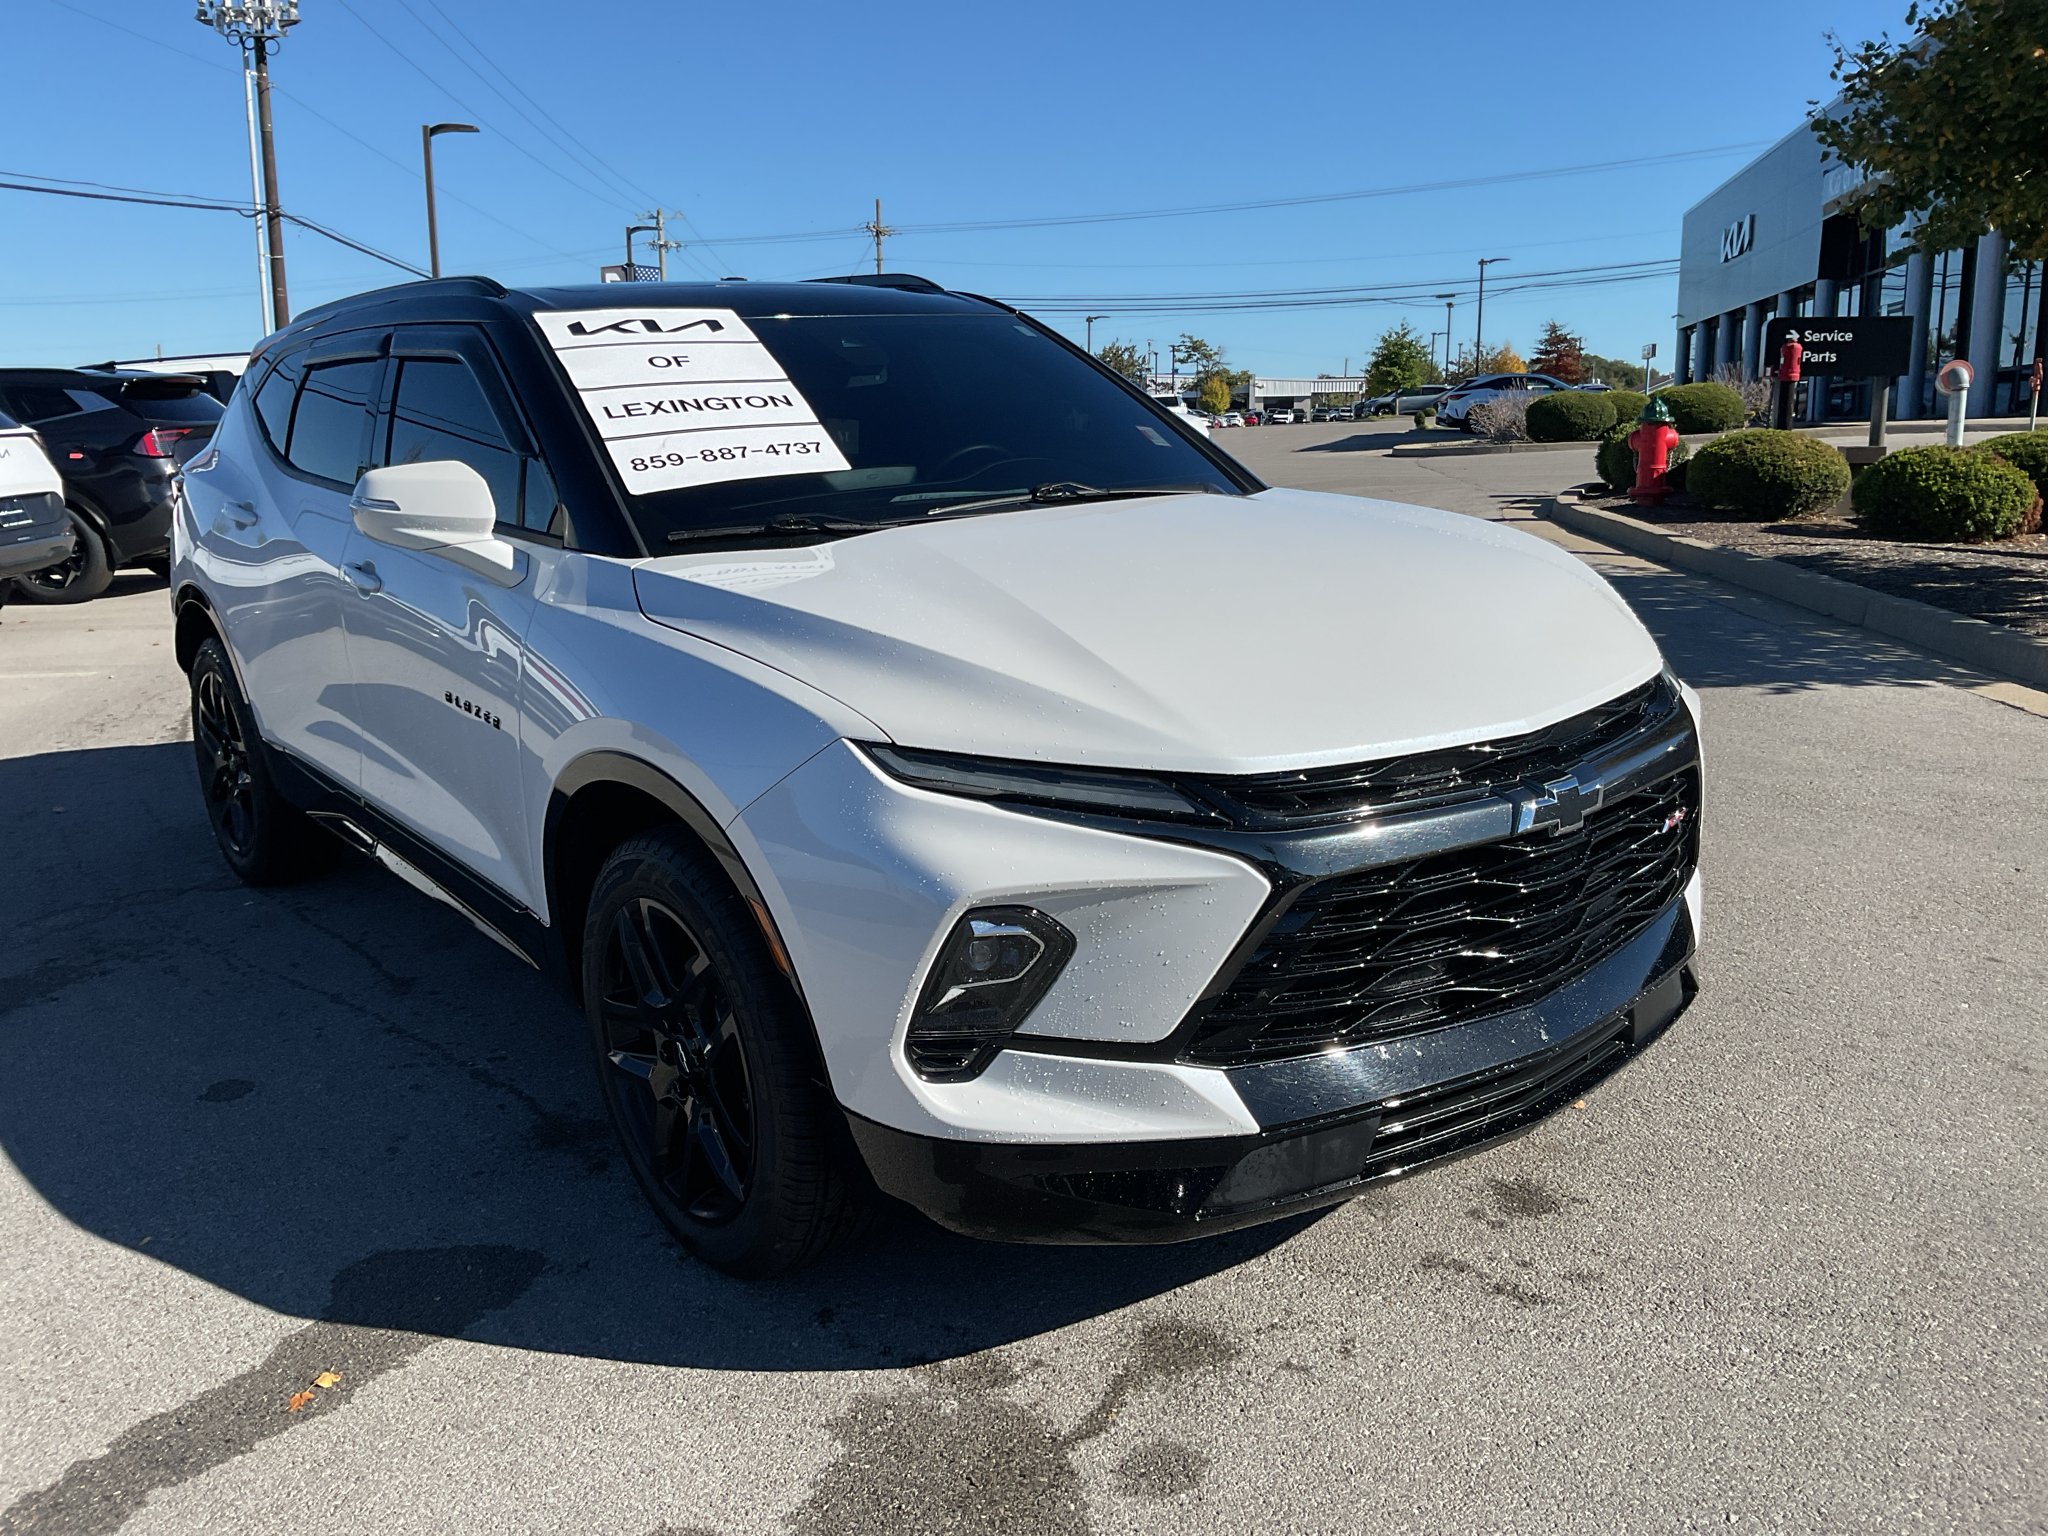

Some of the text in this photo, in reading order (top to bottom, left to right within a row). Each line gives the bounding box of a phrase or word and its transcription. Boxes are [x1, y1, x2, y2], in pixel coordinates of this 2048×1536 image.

[1720, 214, 1755, 264] KIA
[567, 319, 726, 336] KIA
[1803, 329, 1854, 343] Service
[647, 355, 690, 369] OF
[1802, 350, 1838, 363] Parts
[602, 394, 794, 419] LEXINGTON
[630, 441, 822, 472] 859-887-4737
[444, 690, 501, 731] BLAZER
